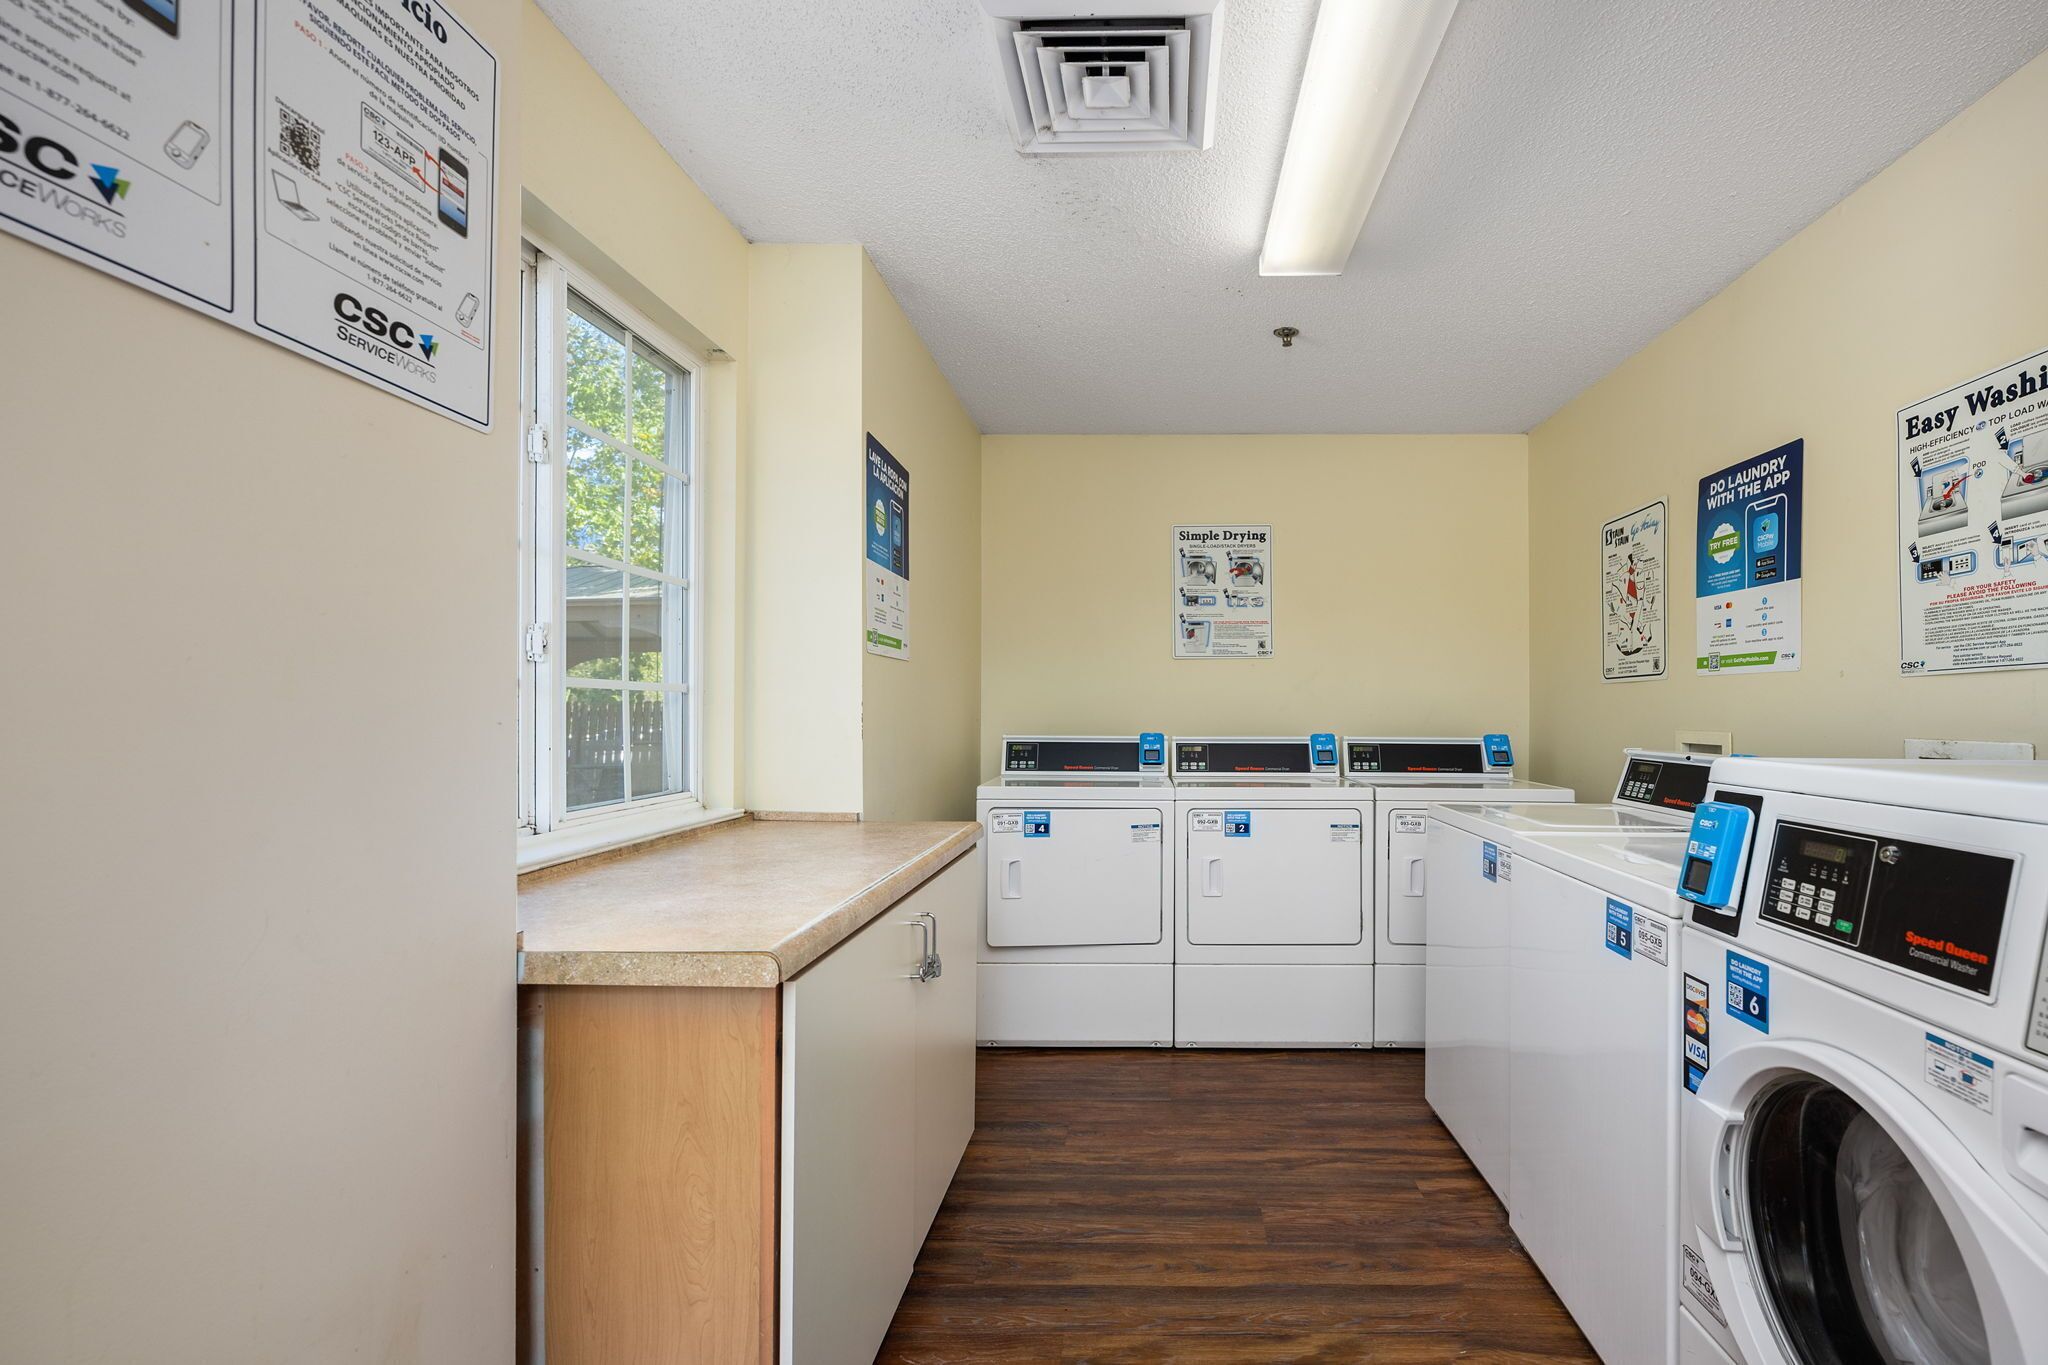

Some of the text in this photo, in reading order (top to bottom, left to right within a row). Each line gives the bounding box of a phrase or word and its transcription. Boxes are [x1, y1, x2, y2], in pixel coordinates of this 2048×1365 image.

[375, 2, 479, 103] IMPORTANTE PARA NOSOTROS
[309, 11, 351, 54] SIGUIENDO
[352, 47, 369, 69] ESTE
[420, 102, 428, 116] DE
[429, 109, 441, 127] DOS
[442, 120, 460, 142] PASOS
[333, 20, 365, 55] REPORTE
[366, 48, 404, 88] CUALQUIER
[406, 81, 437, 115] PROBLEMA
[439, 109, 449, 125] DEL
[384, 34, 465, 112] ES NUESTRA PRIORIDAD
[414, 49, 454, 92] APROPIADO
[373, 127, 416, 169] 123-APP
[333, 292, 415, 349] CSC
[1905, 405, 1959, 440] Easy
[1910, 425, 1975, 454] HIGH-EFFICIENCY
[1988, 414, 2006, 426] TOP
[2008, 405, 2035, 419] LOAD
[1710, 455, 1787, 496] DO LAUNDRY
[1972, 461, 1987, 470] POD
[1707, 470, 1791, 511] WITH THE APP
[1179, 530, 1266, 543] Simple Drying
[1710, 536, 1738, 550] TRY FREE
[1946, 591, 1967, 599] PLEASE
[2000, 580, 2036, 591] FOLLOWING
[1993, 578, 2015, 587] SAFETY
[1900, 661, 1920, 670] CSC
[1239, 824, 1245, 832] 2
[1699, 819, 1712, 827] CSC
[1491, 863, 1494, 874] 1
[1620, 931, 1627, 946] 5
[1905, 931, 1989, 965] Speed Queen
[1730, 958, 1739, 966] DO
[1908, 947, 1979, 976] Commercial Washer
[1749, 996, 1760, 1015] 6
[1688, 1041, 1707, 1062] VISA
[1944, 1041, 1973, 1059] NOTICE
[1689, 1267, 1719, 1302] 094-GX
